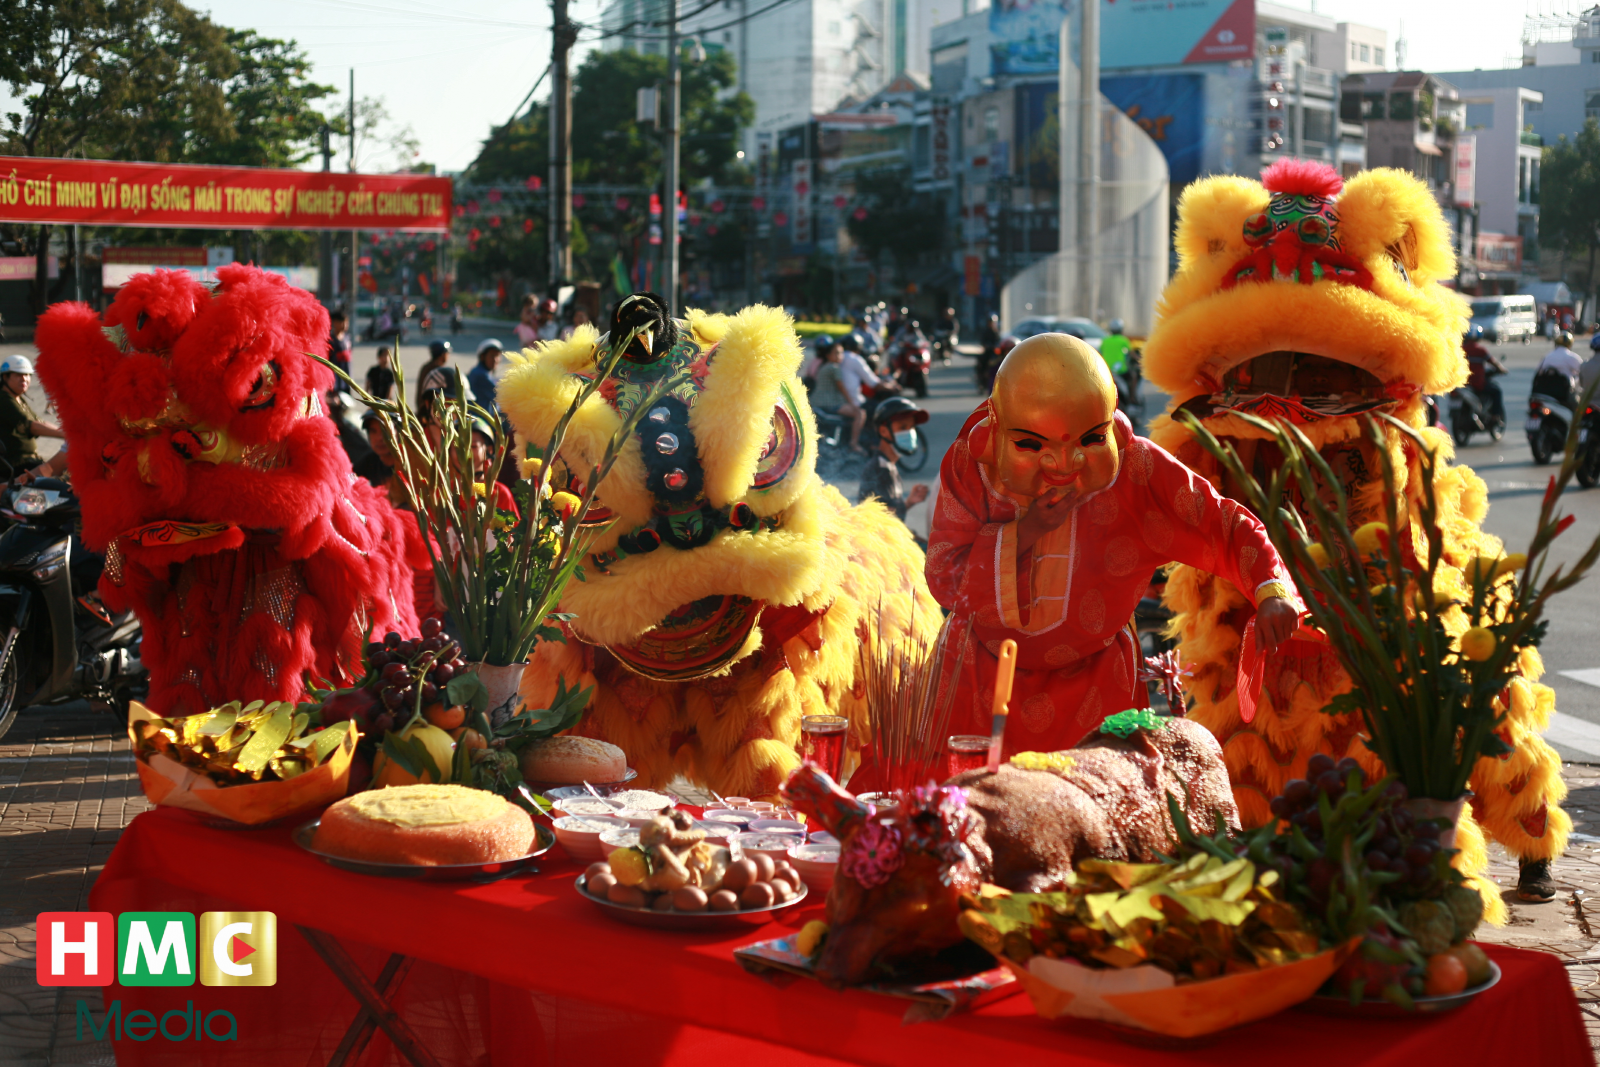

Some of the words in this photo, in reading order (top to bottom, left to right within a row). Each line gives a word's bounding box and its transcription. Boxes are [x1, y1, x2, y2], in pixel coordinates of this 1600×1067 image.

[24, 174, 52, 207] CHÍ
[56, 181, 96, 208] MINH
[120, 183, 147, 215] ĐẠI
[150, 175, 191, 212] SỐNG
[224, 186, 272, 214] TRONG
[297, 184, 345, 219] NGHIỆP
[376, 186, 419, 217] CHÚNG
